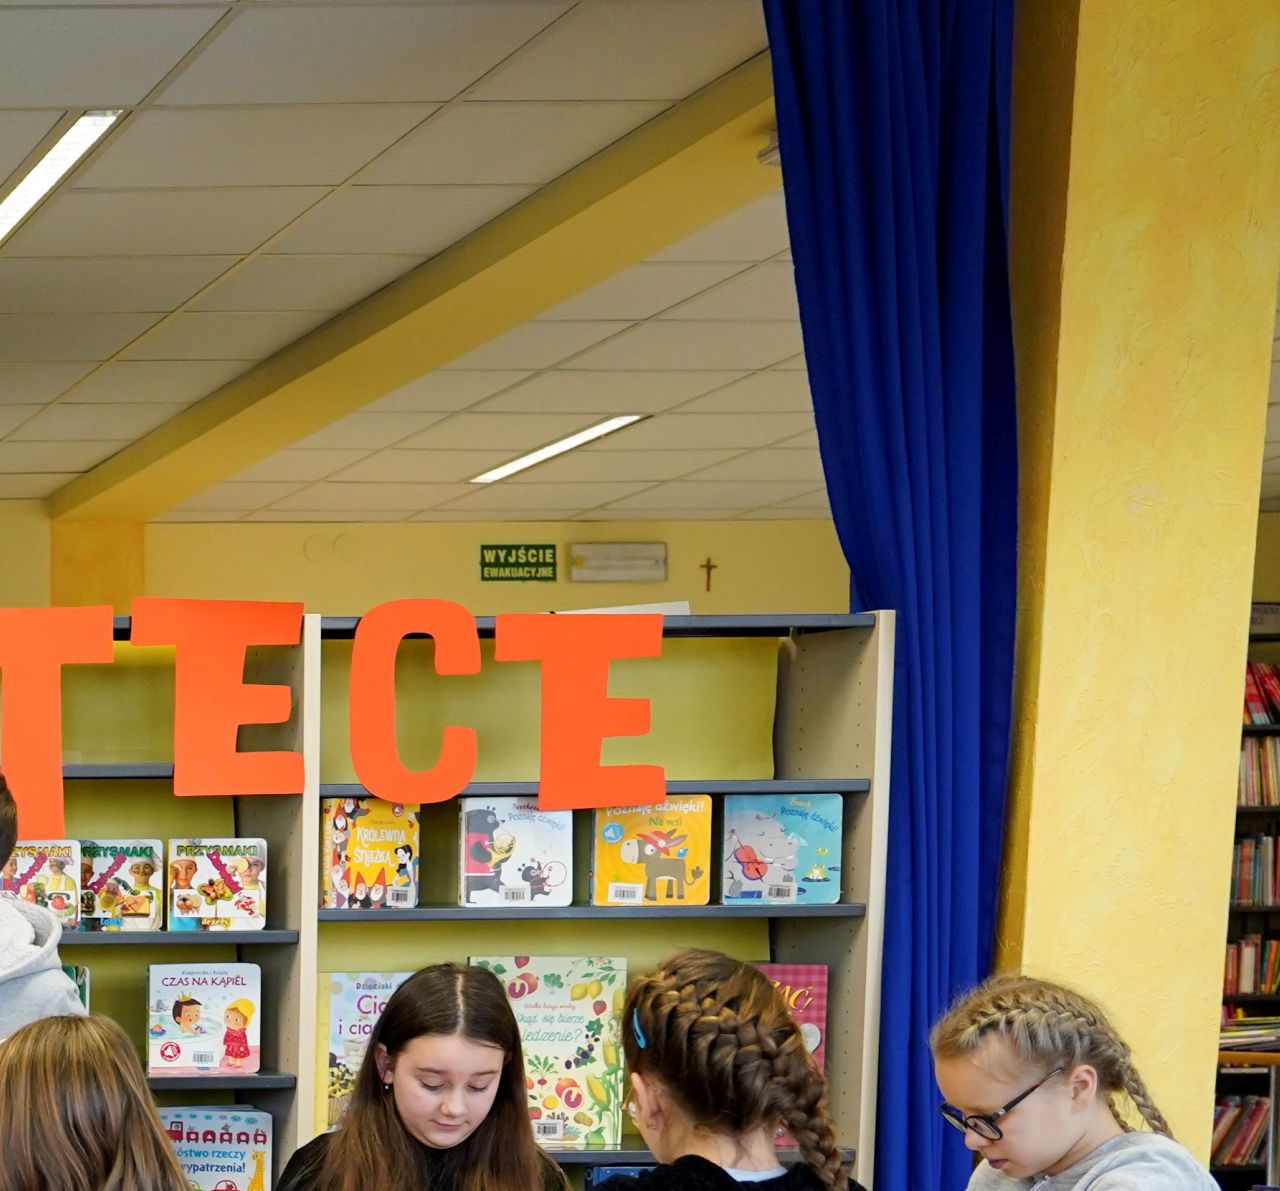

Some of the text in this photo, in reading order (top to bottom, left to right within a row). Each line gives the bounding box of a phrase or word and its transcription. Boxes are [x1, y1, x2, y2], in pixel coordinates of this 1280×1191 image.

[483, 545, 555, 562] WYJŚCIE
[483, 566, 555, 578] EWAKUACYJNE
[655, 799, 705, 815] dźwięki!
[648, 817, 683, 827] Na wsi
[13, 846, 73, 858] ZYSMAKI
[176, 845, 258, 857] PRZYSMAKI
[161, 974, 247, 988] CZAS NA KĄPIEL
[357, 994, 388, 1015] Cia
[338, 1018, 373, 1035] i cia
[176, 1147, 246, 1161] óstwo rzeczy
